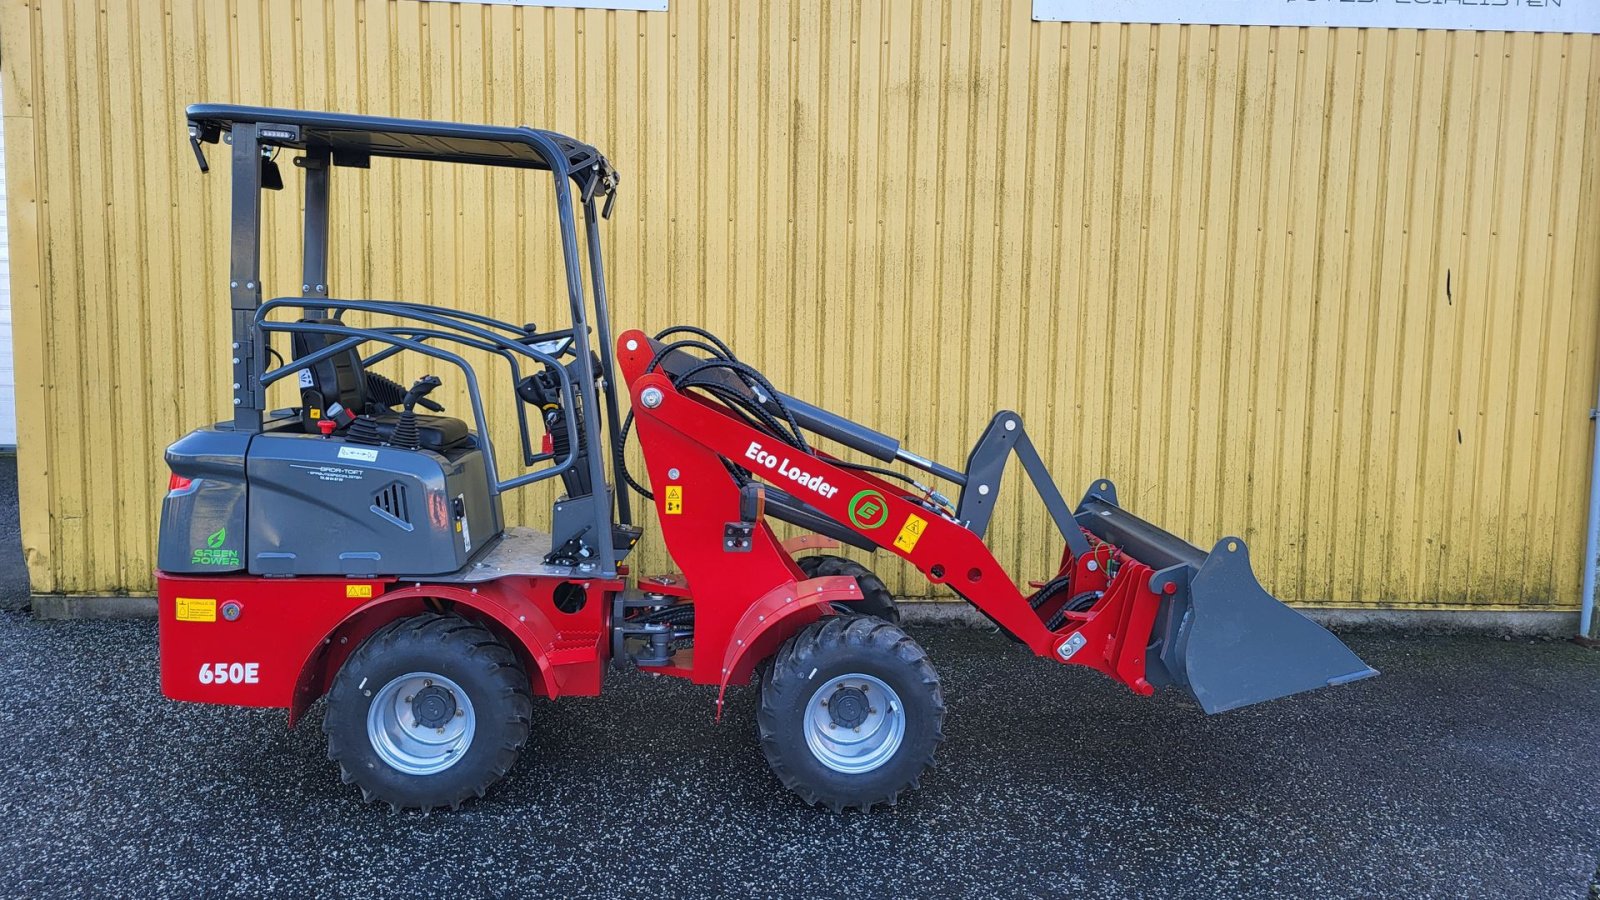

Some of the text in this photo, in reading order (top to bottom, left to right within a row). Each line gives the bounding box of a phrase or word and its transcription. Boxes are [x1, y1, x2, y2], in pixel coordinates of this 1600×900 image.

[745, 441, 838, 499] Eco Loader
[194, 549, 237, 557] GREEN
[191, 557, 239, 565] POWER
[199, 663, 259, 684] 650E
